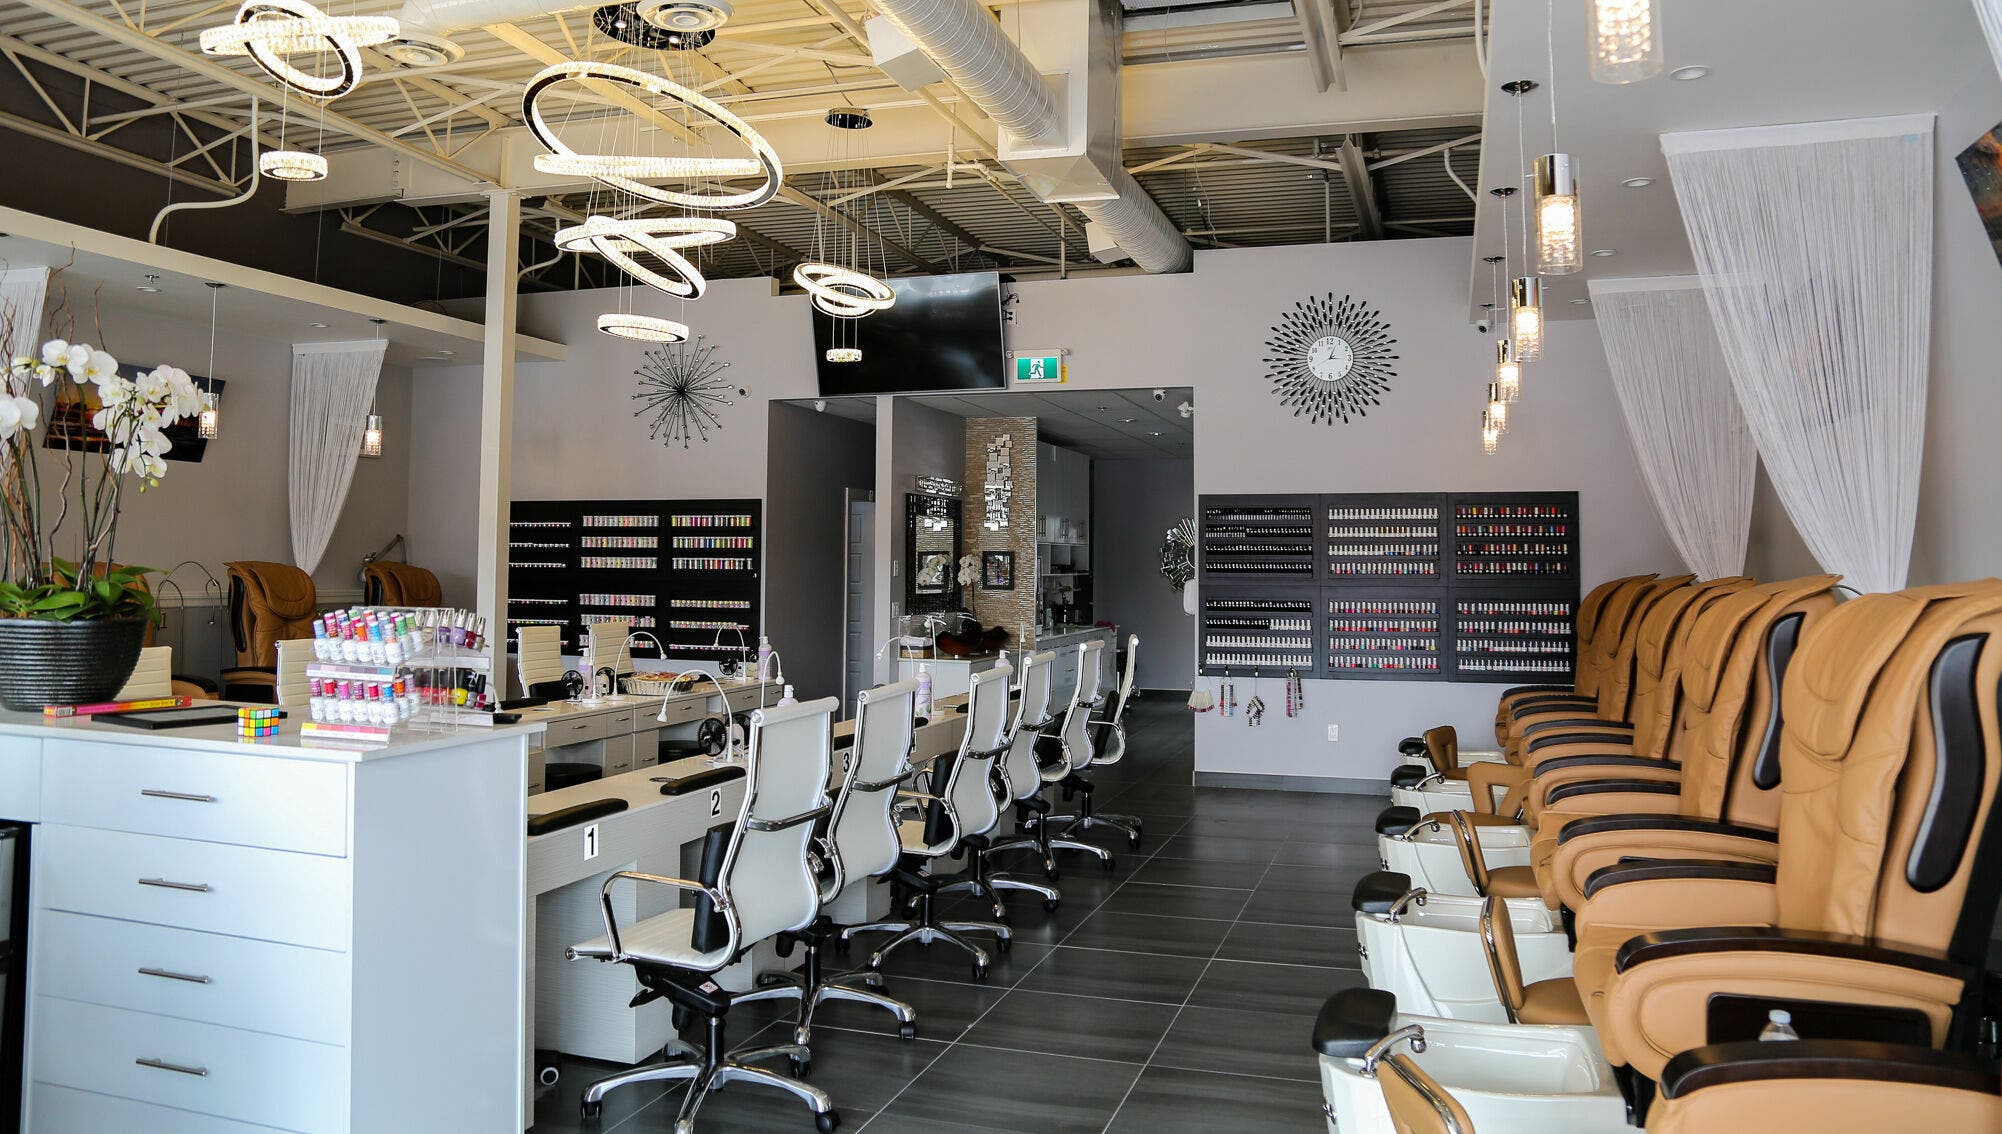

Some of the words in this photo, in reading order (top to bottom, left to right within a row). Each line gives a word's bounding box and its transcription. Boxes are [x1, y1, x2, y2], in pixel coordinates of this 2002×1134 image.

[843, 752, 850, 773] 3
[711, 790, 721, 816] 2
[587, 827, 594, 856] 1
